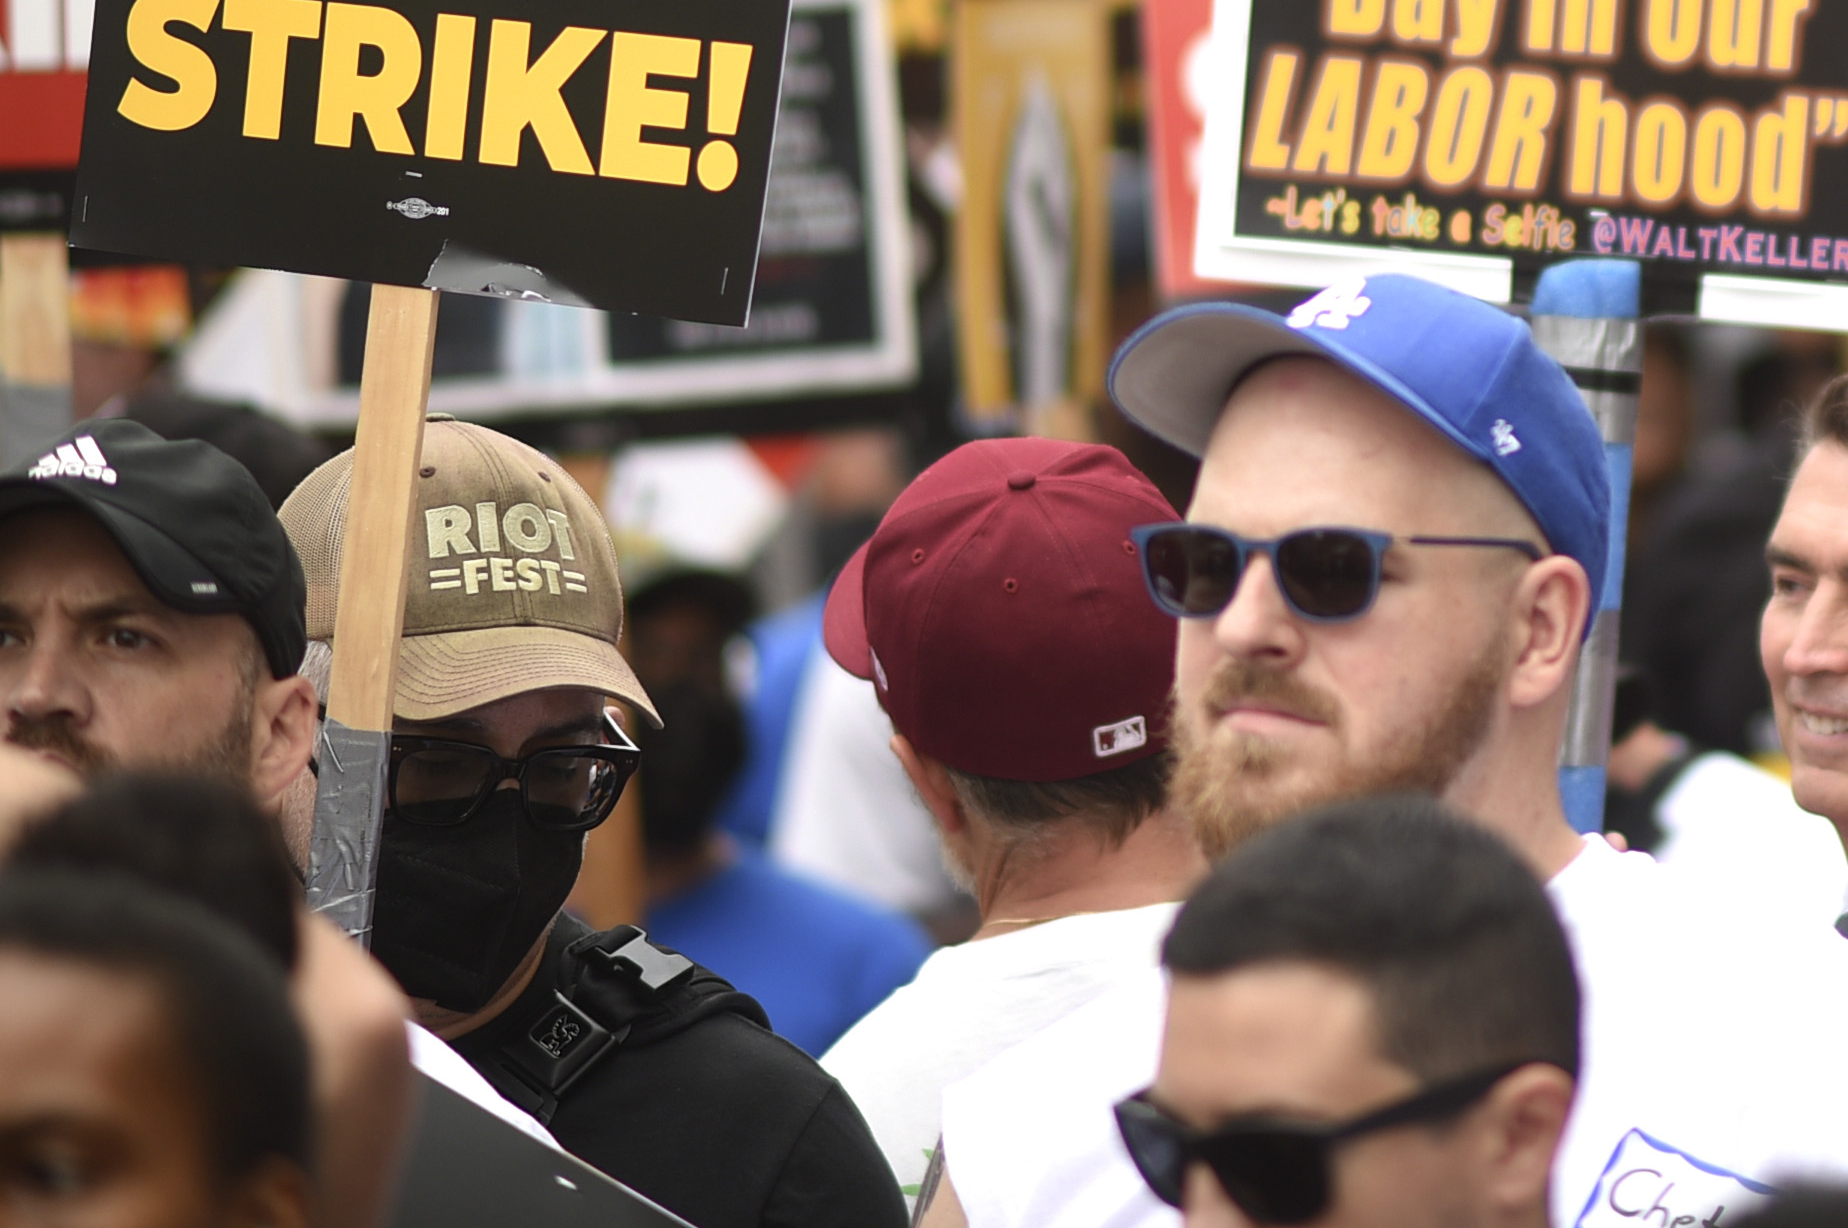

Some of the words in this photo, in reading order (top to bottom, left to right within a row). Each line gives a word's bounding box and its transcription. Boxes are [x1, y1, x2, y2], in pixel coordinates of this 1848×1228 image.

[1250, 53, 1556, 189] LABOR
[1371, 192, 1441, 241] take
[1450, 210, 1472, 244] a
[1481, 202, 1576, 252] Selfie
[425, 501, 575, 560] RIOT
